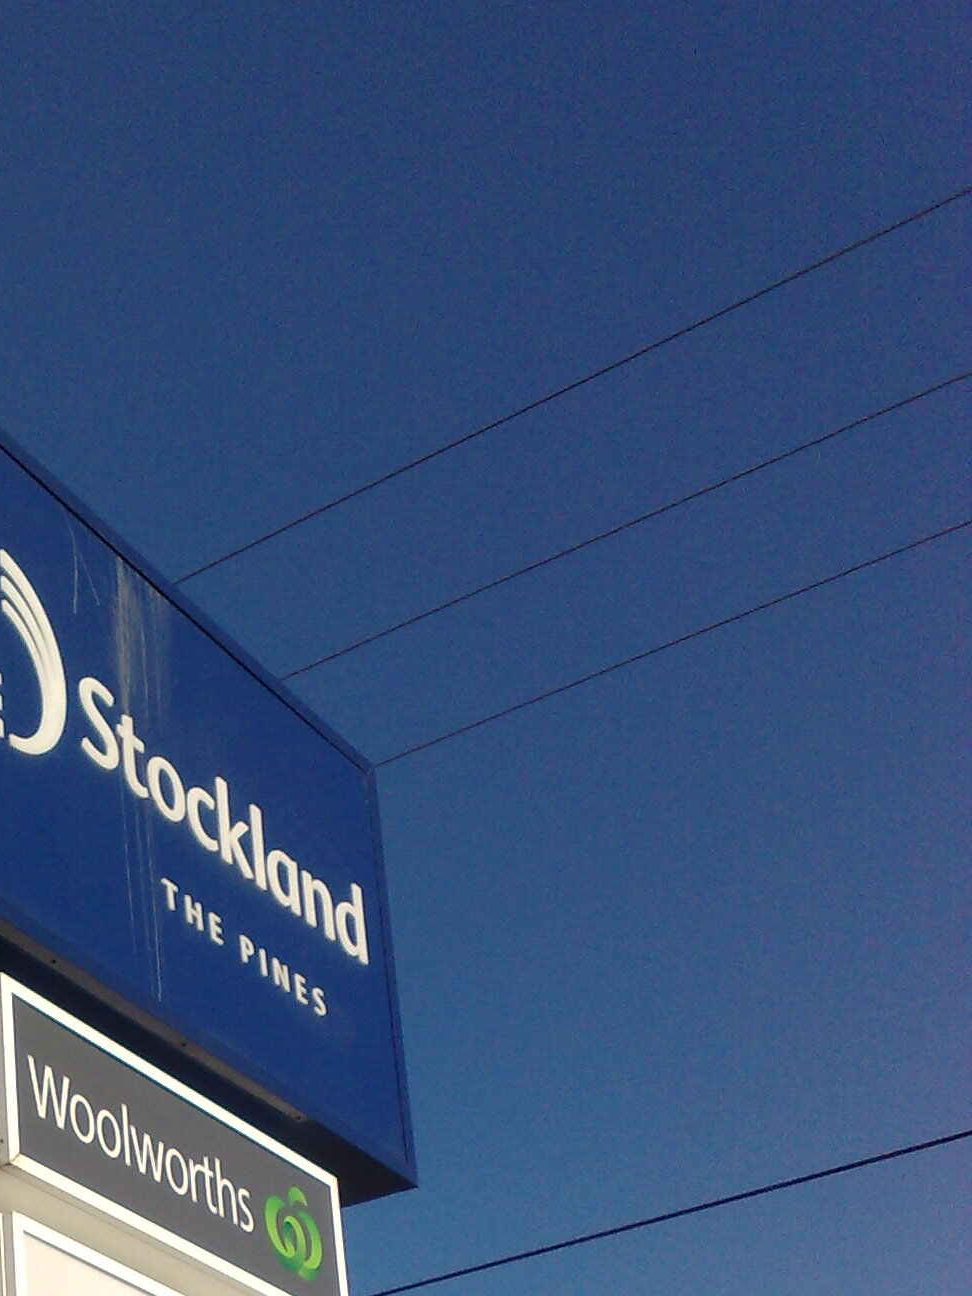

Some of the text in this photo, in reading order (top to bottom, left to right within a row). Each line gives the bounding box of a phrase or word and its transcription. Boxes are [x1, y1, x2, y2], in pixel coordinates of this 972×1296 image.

[79, 676, 369, 965] Stockland
[161, 877, 327, 1016] THE PINES
[27, 1054, 255, 1233] Woolworths
